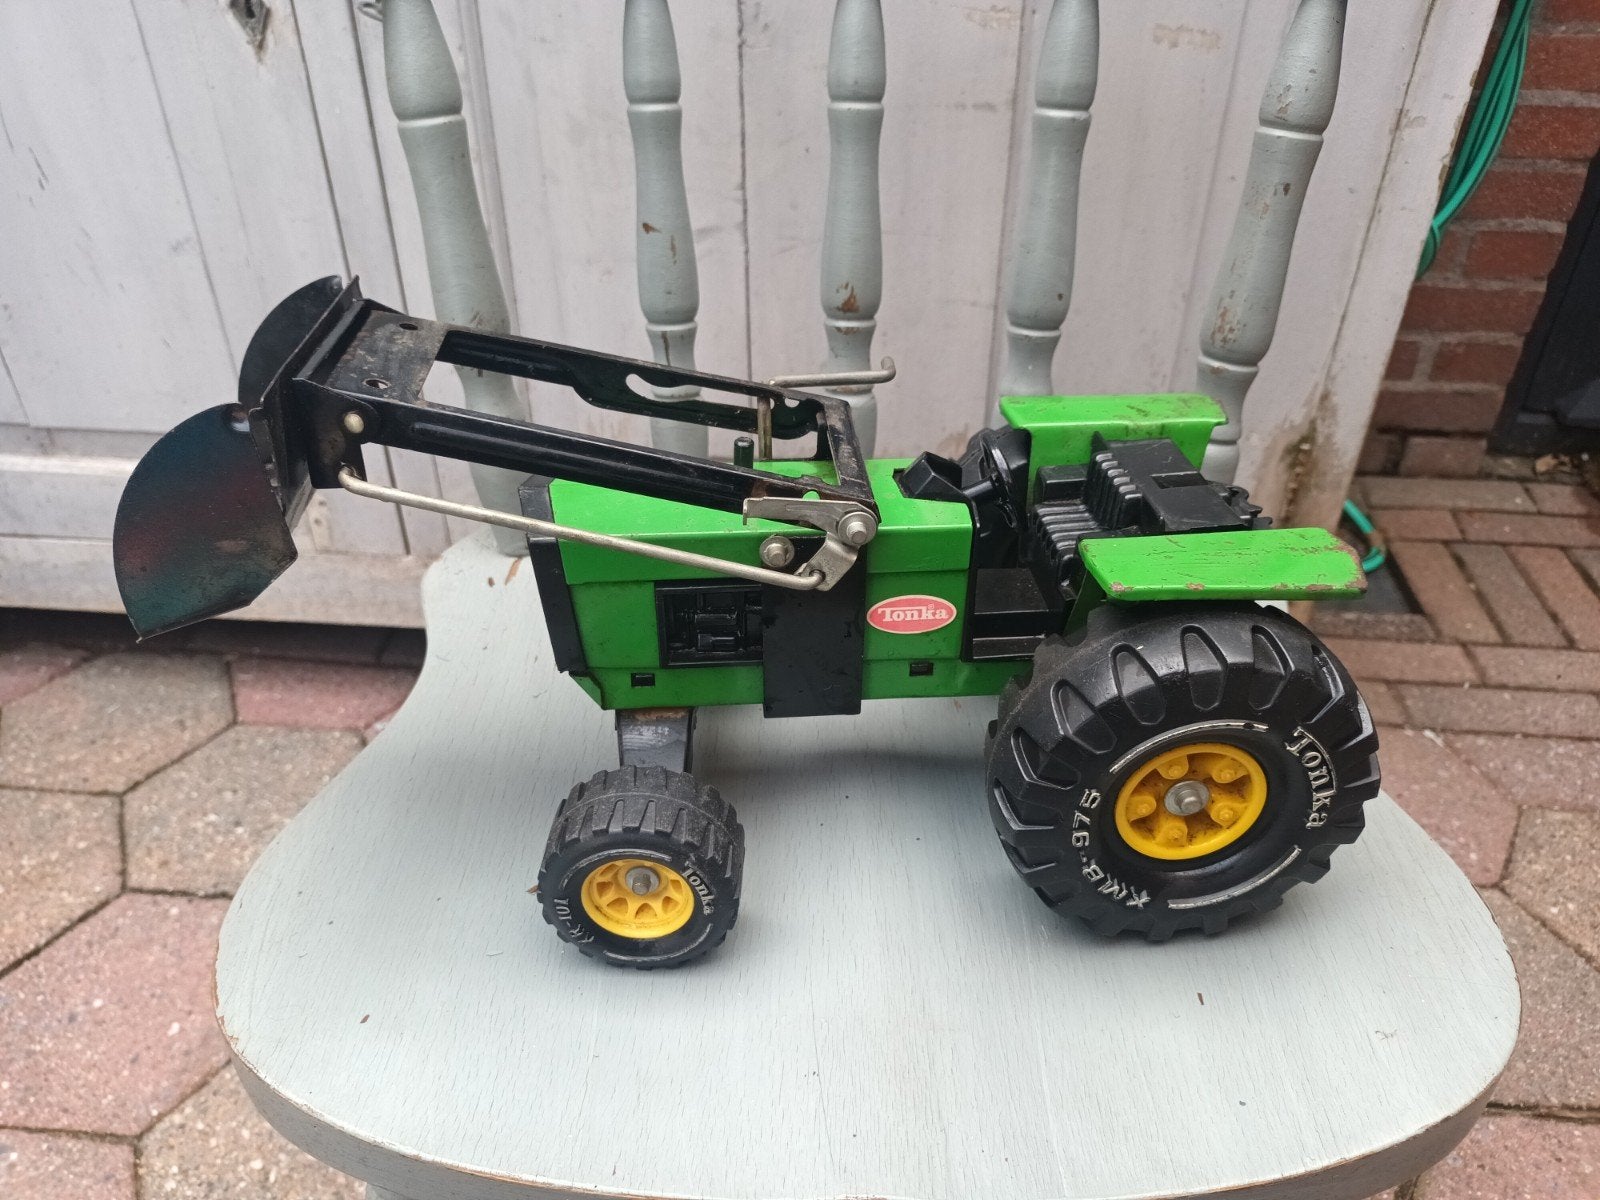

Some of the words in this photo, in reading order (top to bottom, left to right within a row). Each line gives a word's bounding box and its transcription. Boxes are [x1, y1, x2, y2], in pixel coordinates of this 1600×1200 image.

[877, 604, 950, 622] Tonka
[1284, 726, 1337, 829] Tonka
[682, 860, 715, 916] Tonka
